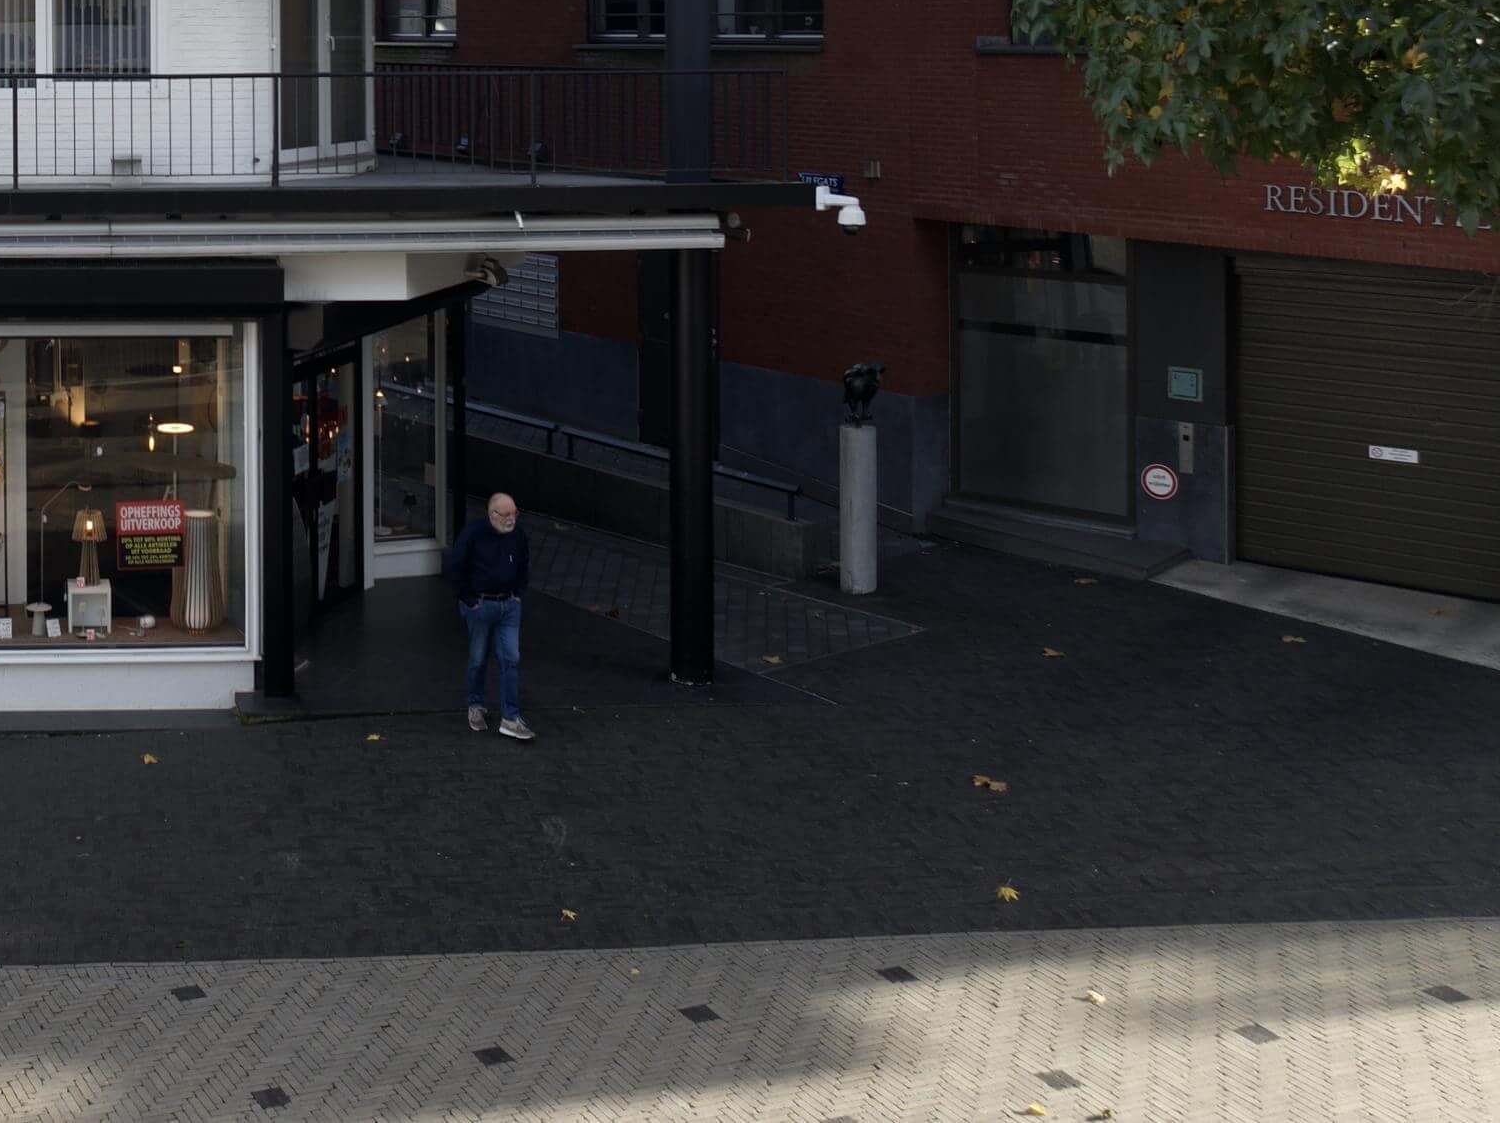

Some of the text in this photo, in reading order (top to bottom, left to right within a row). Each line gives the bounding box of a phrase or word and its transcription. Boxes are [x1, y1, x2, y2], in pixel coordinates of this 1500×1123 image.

[1261, 184, 1492, 230] RESIDENT
[120, 504, 181, 518] OPHEFFINGS
[120, 517, 181, 531] UITVERKOOP
